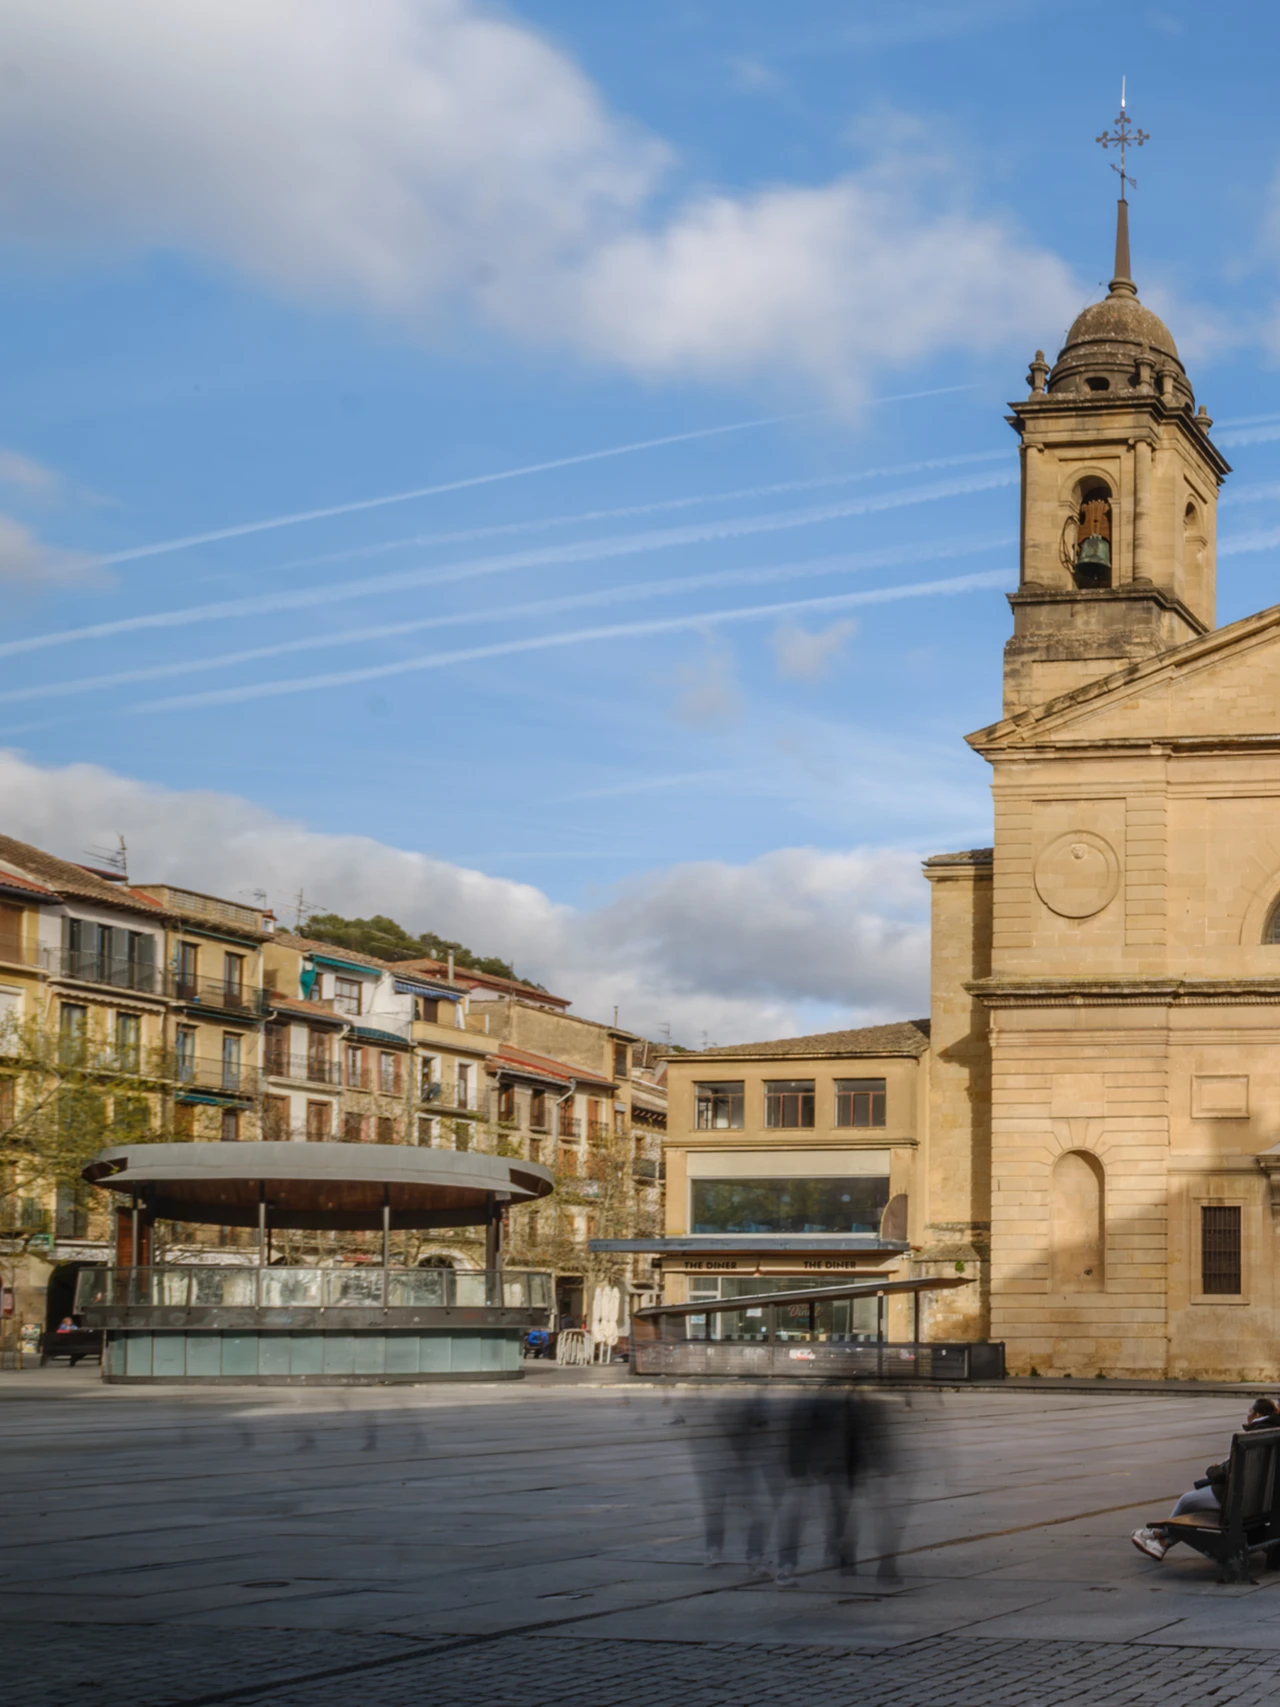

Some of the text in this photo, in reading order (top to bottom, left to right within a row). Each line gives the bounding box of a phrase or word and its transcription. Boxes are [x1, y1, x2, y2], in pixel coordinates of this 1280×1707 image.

[684, 1261, 738, 1270] THE DINER
[803, 1260, 857, 1269] THE DINER
